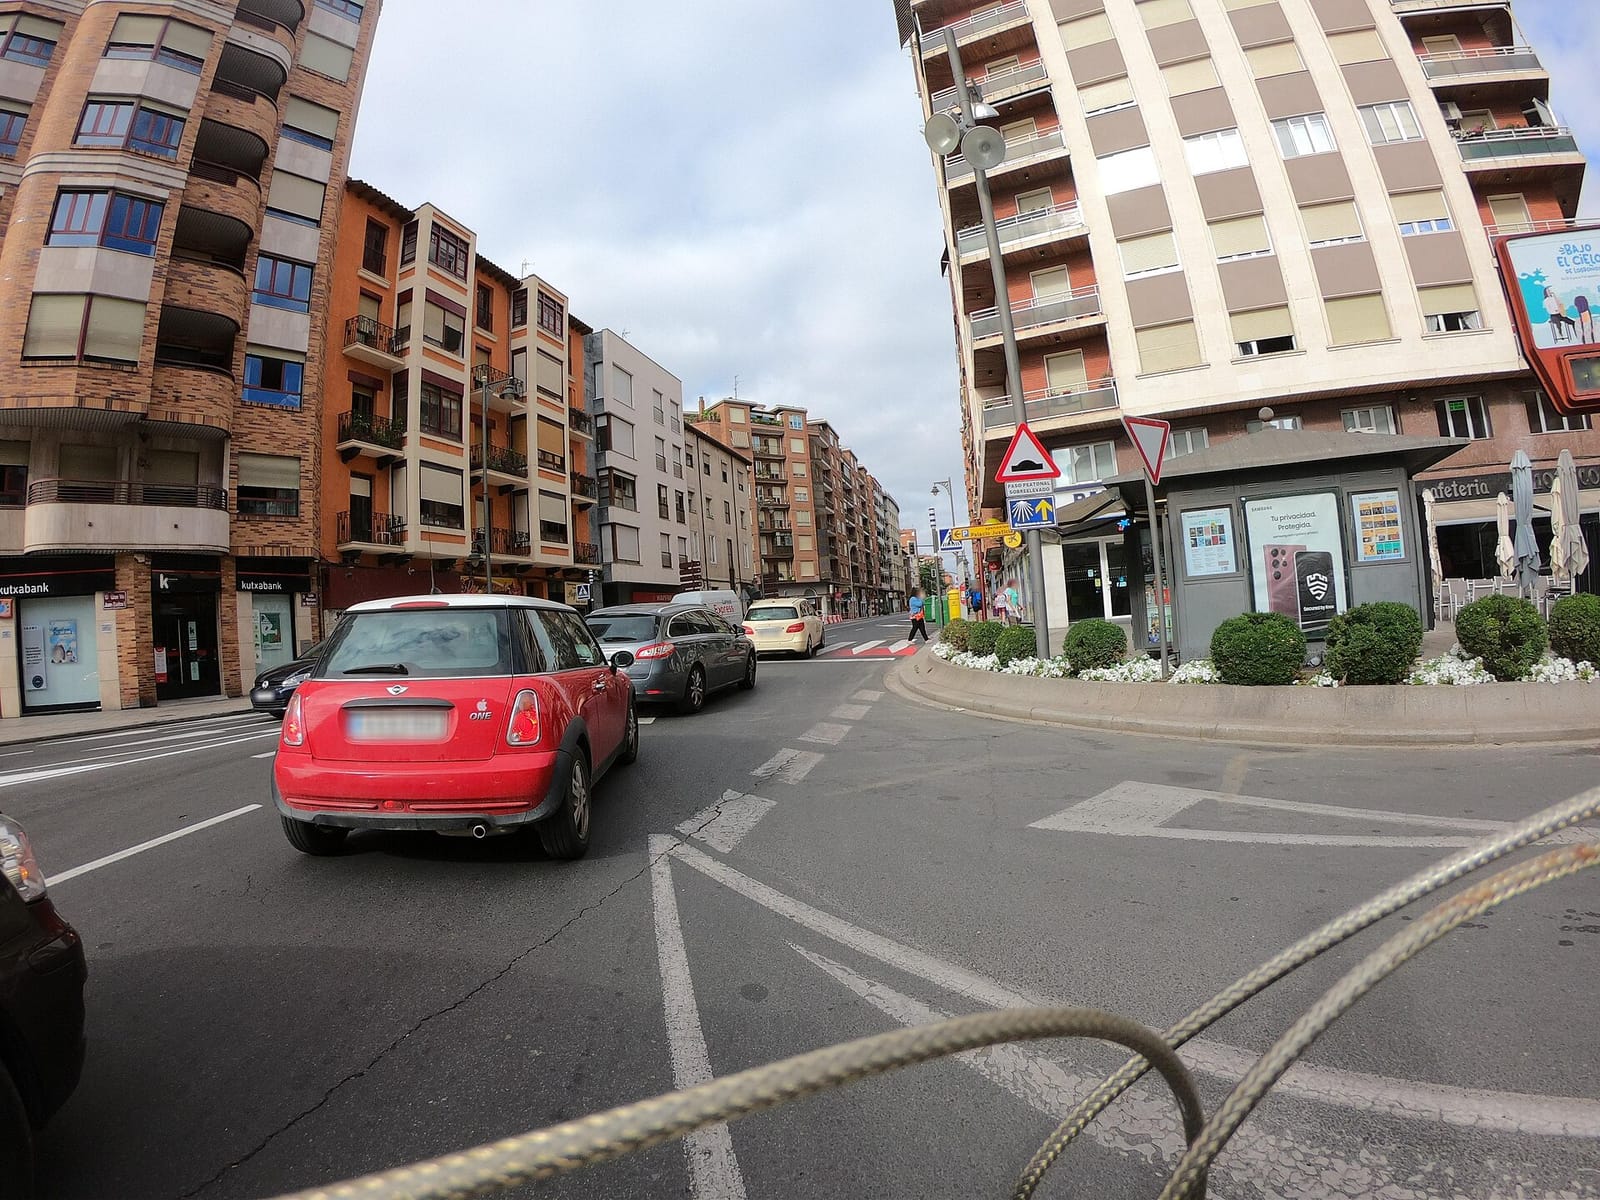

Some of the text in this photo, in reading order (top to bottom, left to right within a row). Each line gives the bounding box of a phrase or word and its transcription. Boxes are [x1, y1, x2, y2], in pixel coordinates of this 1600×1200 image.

[1563, 243, 1592, 256] BAJO
[1423, 478, 1490, 499] afeteria
[241, 580, 282, 590] kutxabank
[469, 711, 492, 720] ONE
